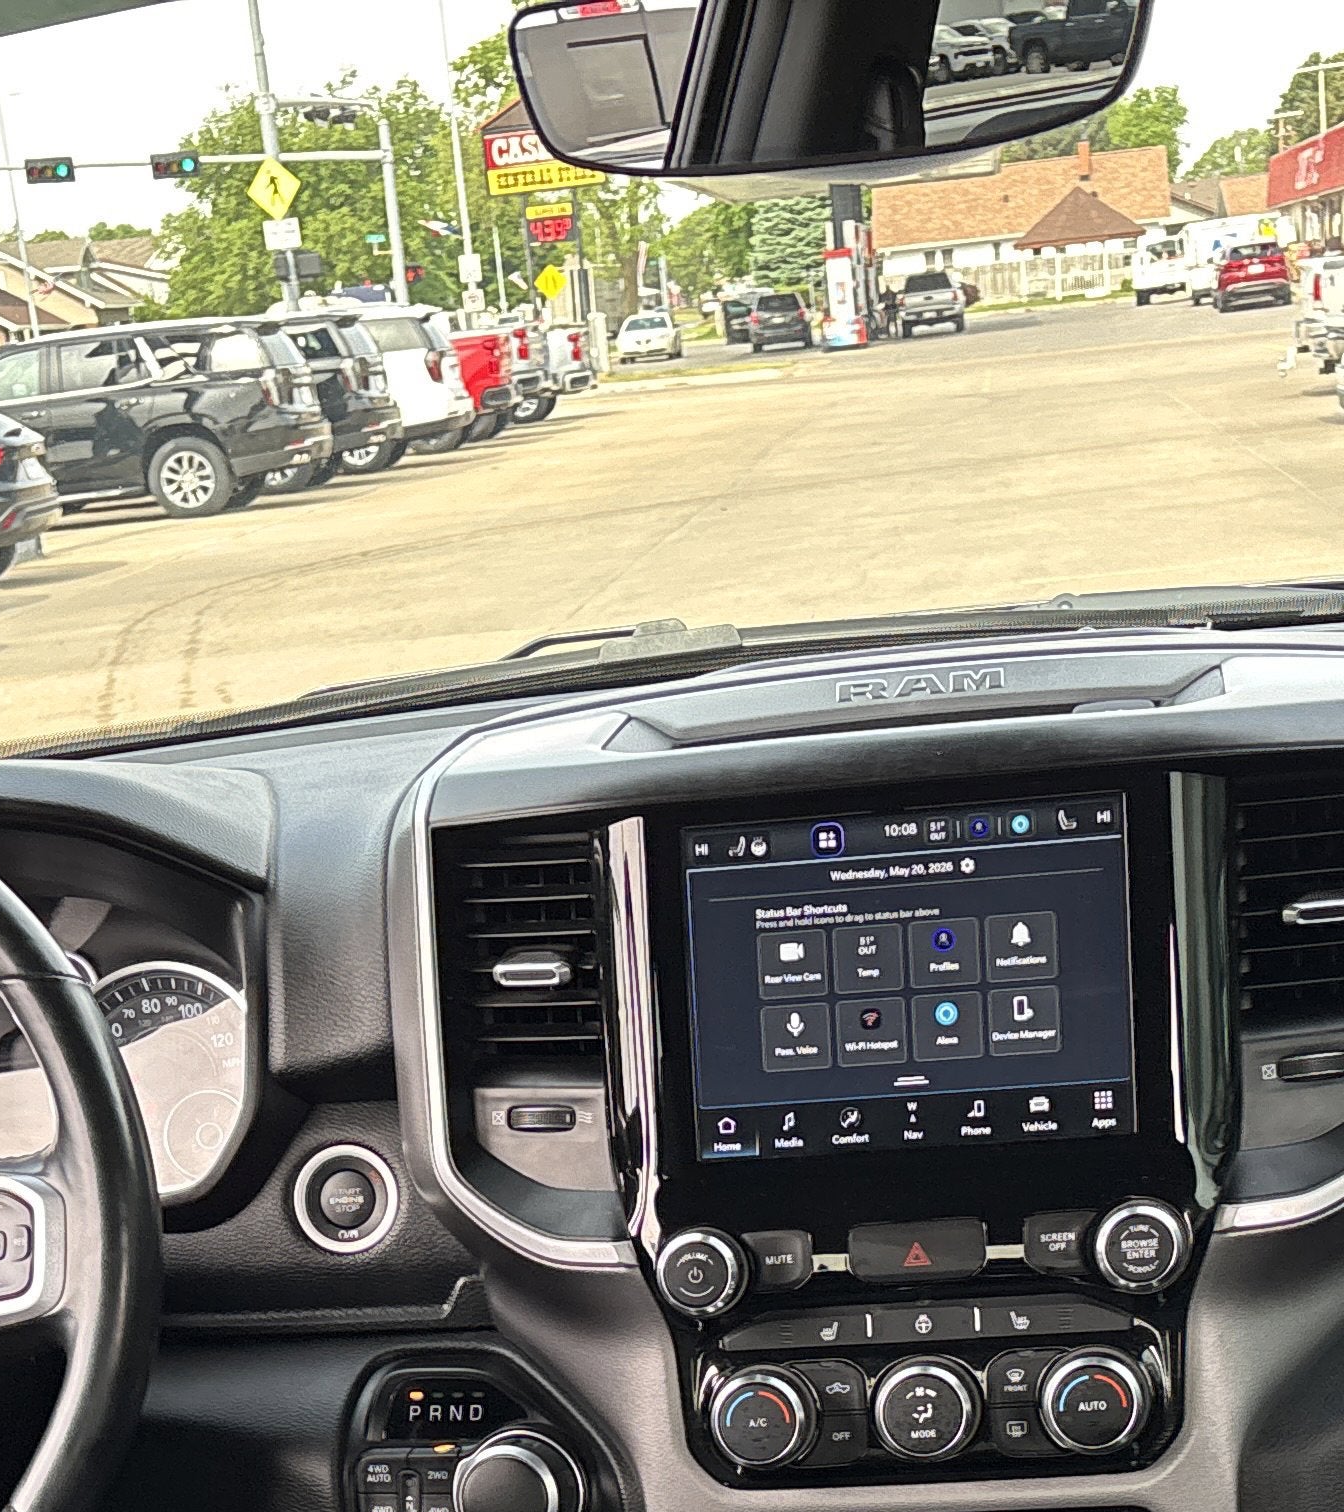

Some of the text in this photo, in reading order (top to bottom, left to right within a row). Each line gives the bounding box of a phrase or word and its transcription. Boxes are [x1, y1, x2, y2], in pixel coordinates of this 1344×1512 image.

[836, 667, 1005, 702] RAM
[1096, 810, 1111, 823] HI
[884, 823, 917, 837] 10:08
[695, 844, 709, 856] HI
[830, 862, 954, 881] Wednesday, May 20, 2026
[756, 904, 848, 919] Status Bar Shortcuts
[858, 945, 877, 955] OUT
[996, 955, 1047, 966] Notifications
[857, 968, 879, 978] Temp
[141, 998, 160, 1014] 80
[165, 996, 177, 1006] 90
[122, 1008, 136, 1018] 70
[178, 1002, 203, 1019] 100
[111, 1022, 123, 1038] 0
[992, 1029, 1056, 1041] Device Manager
[211, 1032, 234, 1048] 120
[867, 1040, 898, 1051] Hotspot
[1022, 1121, 1058, 1132] Vehicle
[1091, 1118, 1116, 1129] Apps
[904, 1130, 923, 1141] Nav
[961, 1126, 991, 1136] Phone
[774, 1137, 804, 1148] Media
[832, 1133, 869, 1145] Comfort
[714, 1141, 741, 1152] Home
[336, 1187, 362, 1196] TART
[336, 1205, 360, 1213] STOP
[1040, 1231, 1076, 1243] SCREEN
[1048, 1242, 1067, 1252] OFF
[1121, 1238, 1159, 1249] BROWSE
[765, 1253, 794, 1265] MUTE
[1126, 1250, 1156, 1260] ENTER
[1078, 1401, 1107, 1412] AUTO
[409, 1404, 483, 1421] P R N D
[749, 1417, 767, 1428] A/C
[832, 1431, 851, 1441] OFF
[910, 1428, 936, 1438] MODE
[367, 1465, 389, 1474] 4WD
[367, 1474, 391, 1483] AUTO
[427, 1471, 448, 1480] 2WD
